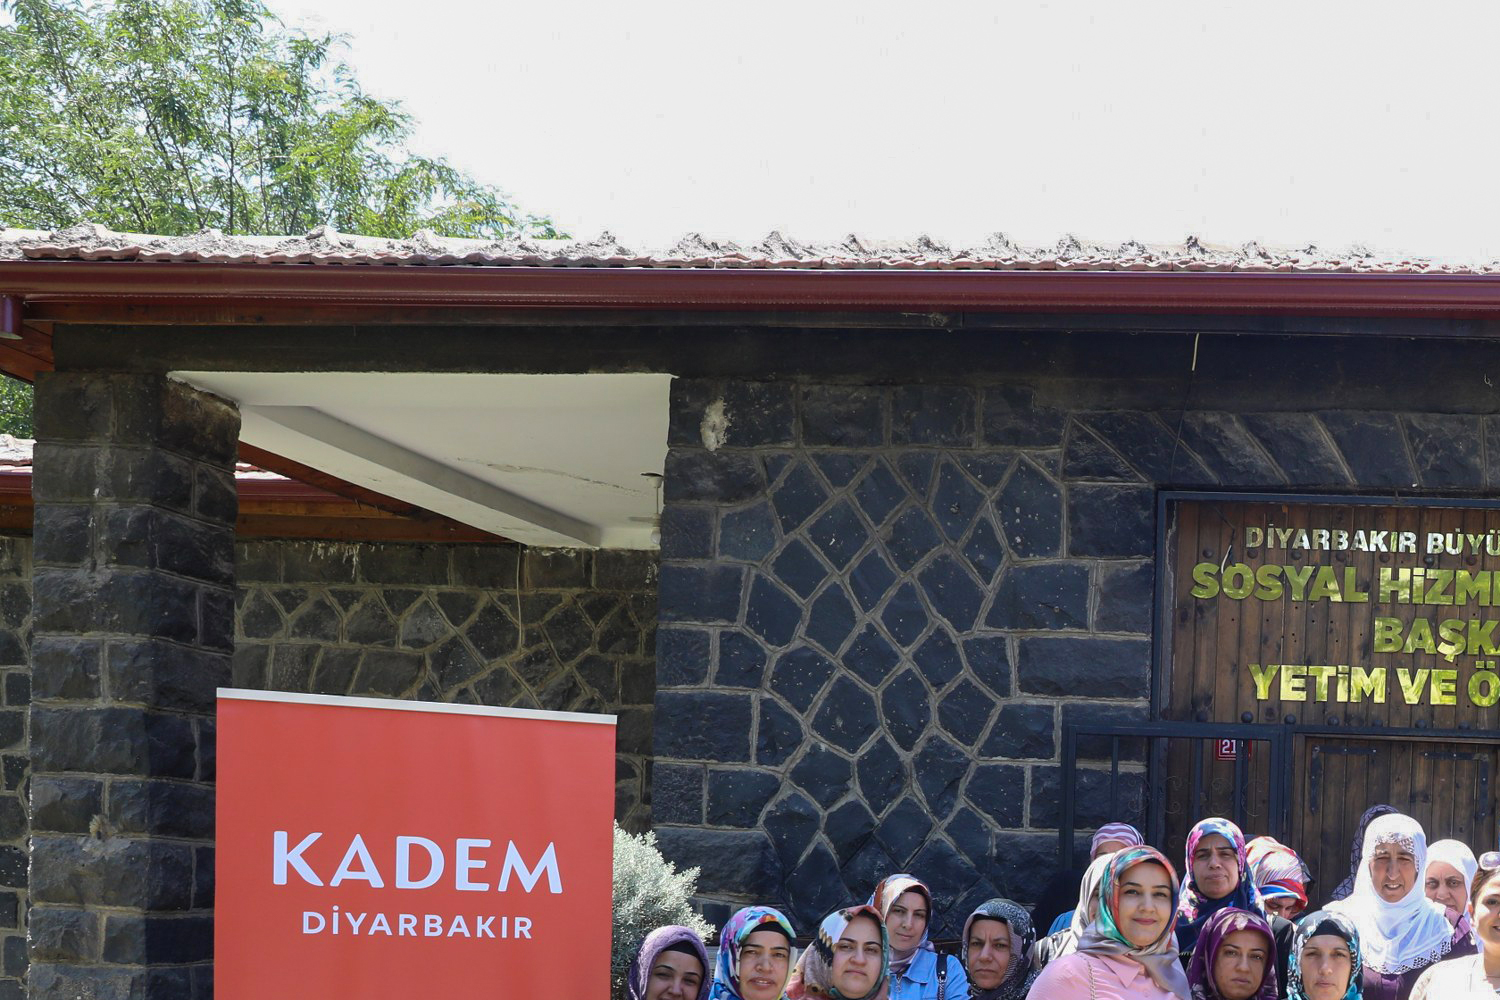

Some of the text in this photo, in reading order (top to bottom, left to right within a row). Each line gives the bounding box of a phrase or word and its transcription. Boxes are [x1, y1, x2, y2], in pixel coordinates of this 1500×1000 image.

[1245, 524, 1417, 554] DİYARBAKIR
[1190, 562, 1369, 603] SOSYAL
[1396, 668, 1458, 706] VE
[272, 830, 563, 894] KADEM
[302, 905, 533, 939] DİYARBAKIR
